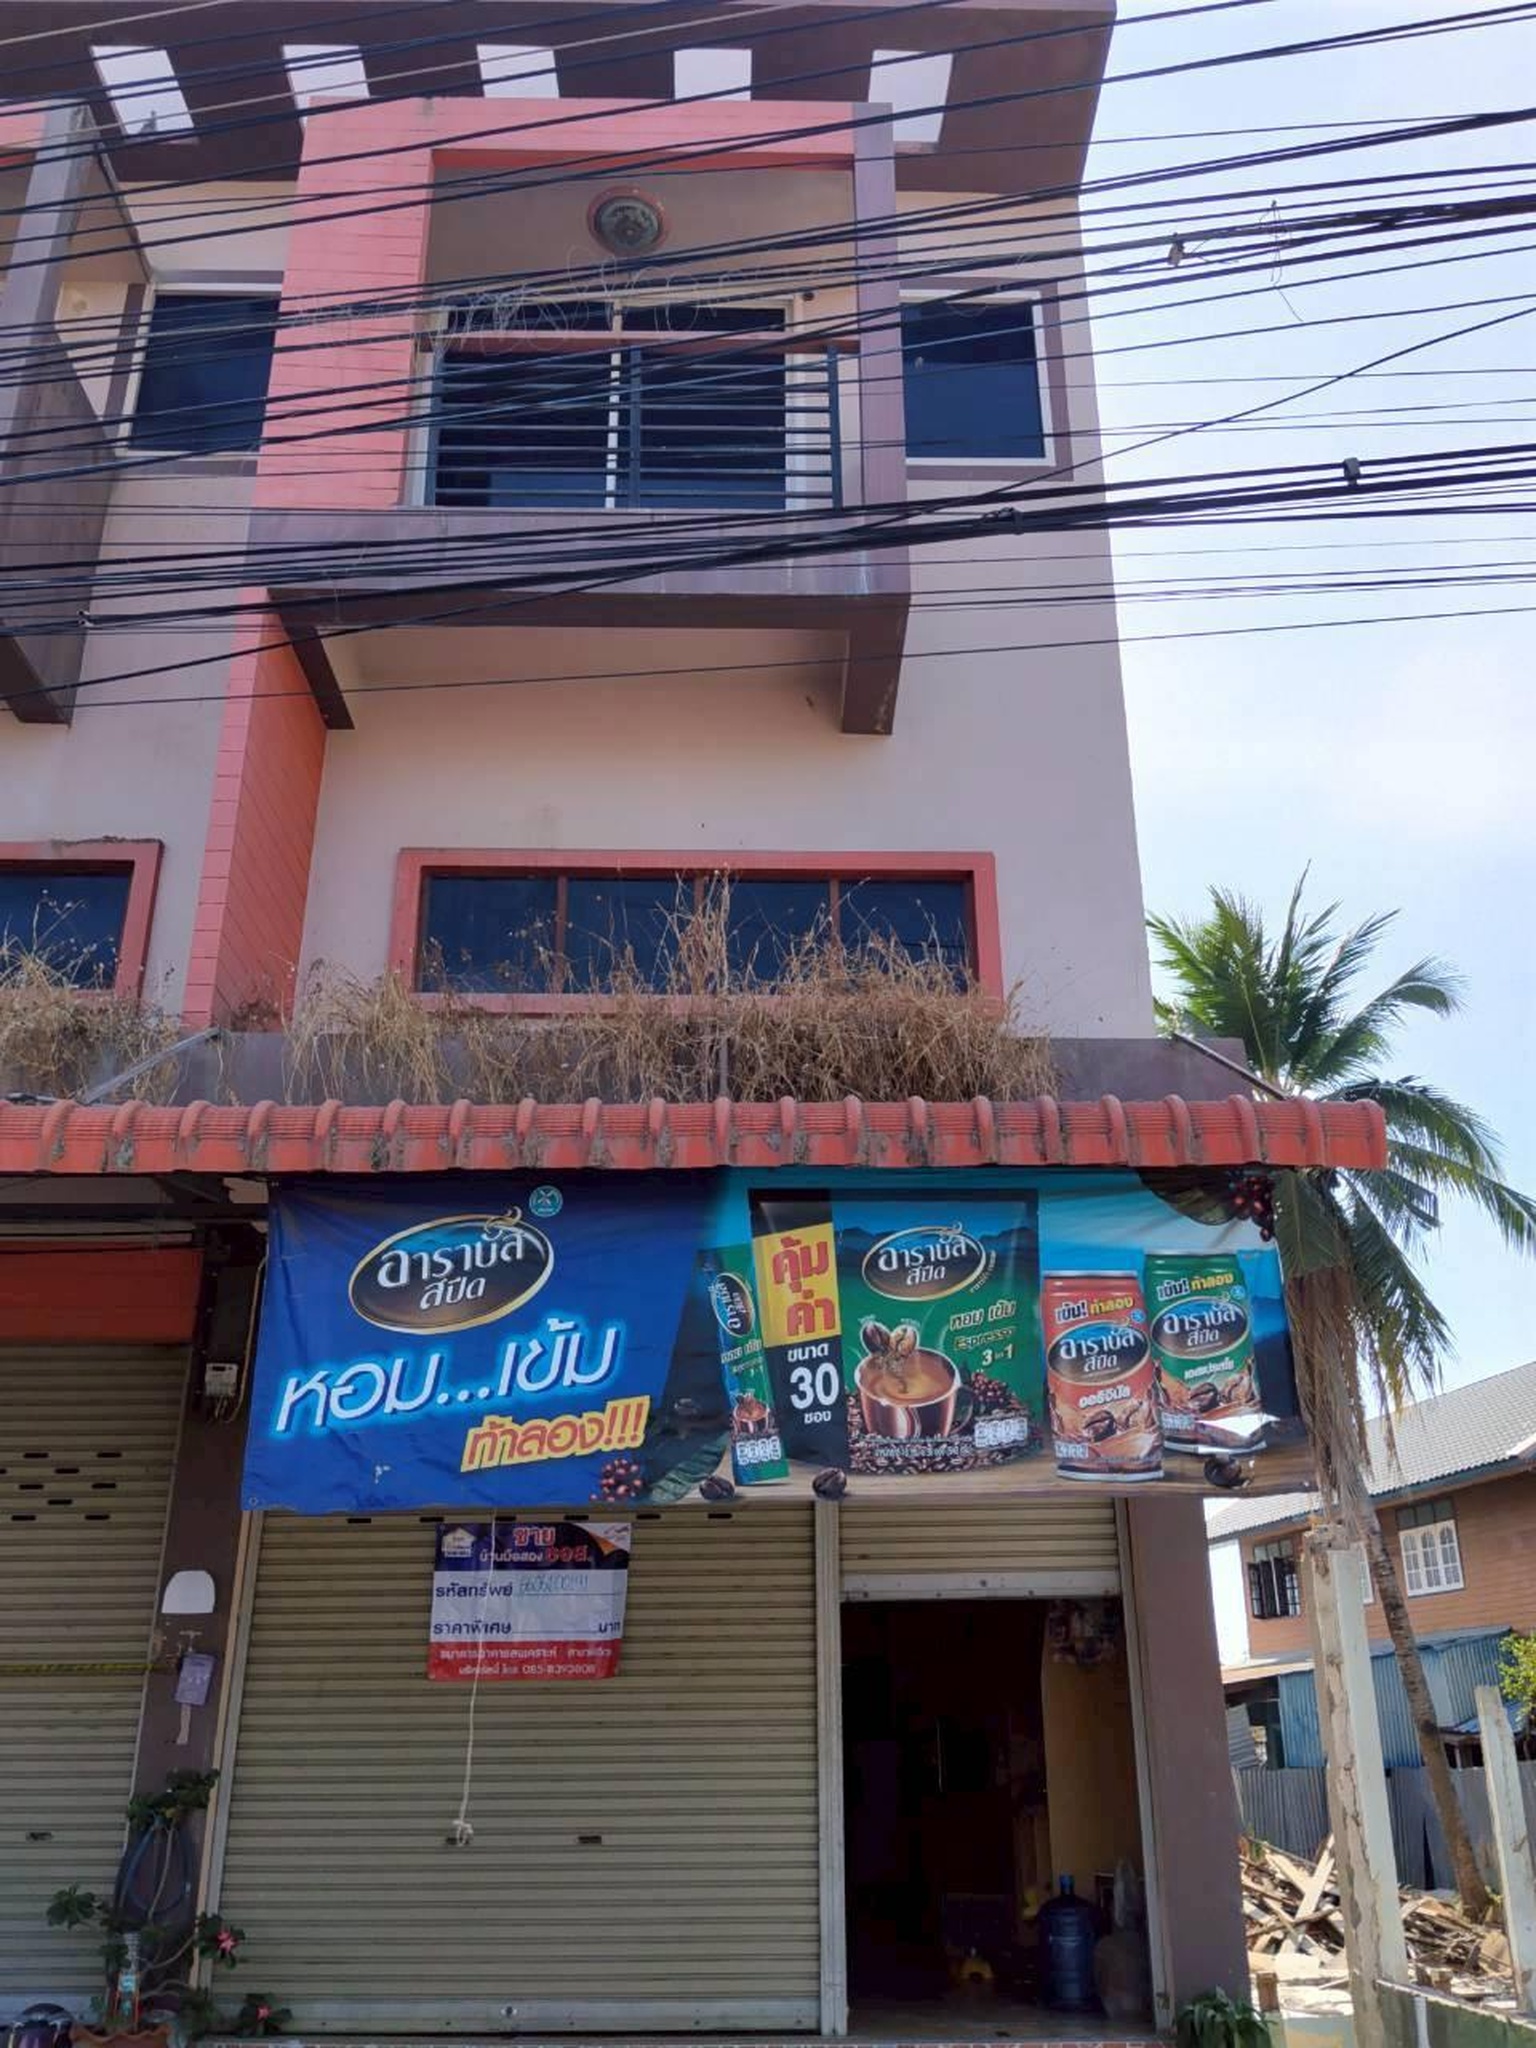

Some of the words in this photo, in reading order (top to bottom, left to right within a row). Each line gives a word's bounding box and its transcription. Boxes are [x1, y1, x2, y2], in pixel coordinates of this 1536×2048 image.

[376, 1229, 525, 1288] อาราบัส
[772, 1236, 830, 1293] คุ้ม
[877, 1234, 967, 1272] อาราบัส
[420, 1275, 487, 1311] สปีด
[786, 1289, 836, 1337] ค่า
[787, 1343, 829, 1362] ขนาด
[982, 1349, 993, 1366] 3
[1059, 1327, 1136, 1360] อาราบัส
[789, 1362, 840, 1409] 30
[465, 1401, 645, 1468] ท้าลอง!!!
[513, 1527, 557, 1547] ขาย
[435, 1581, 514, 1598] รหัสทรัพย์
[433, 1619, 513, 1636] ราคาพิเศษ
